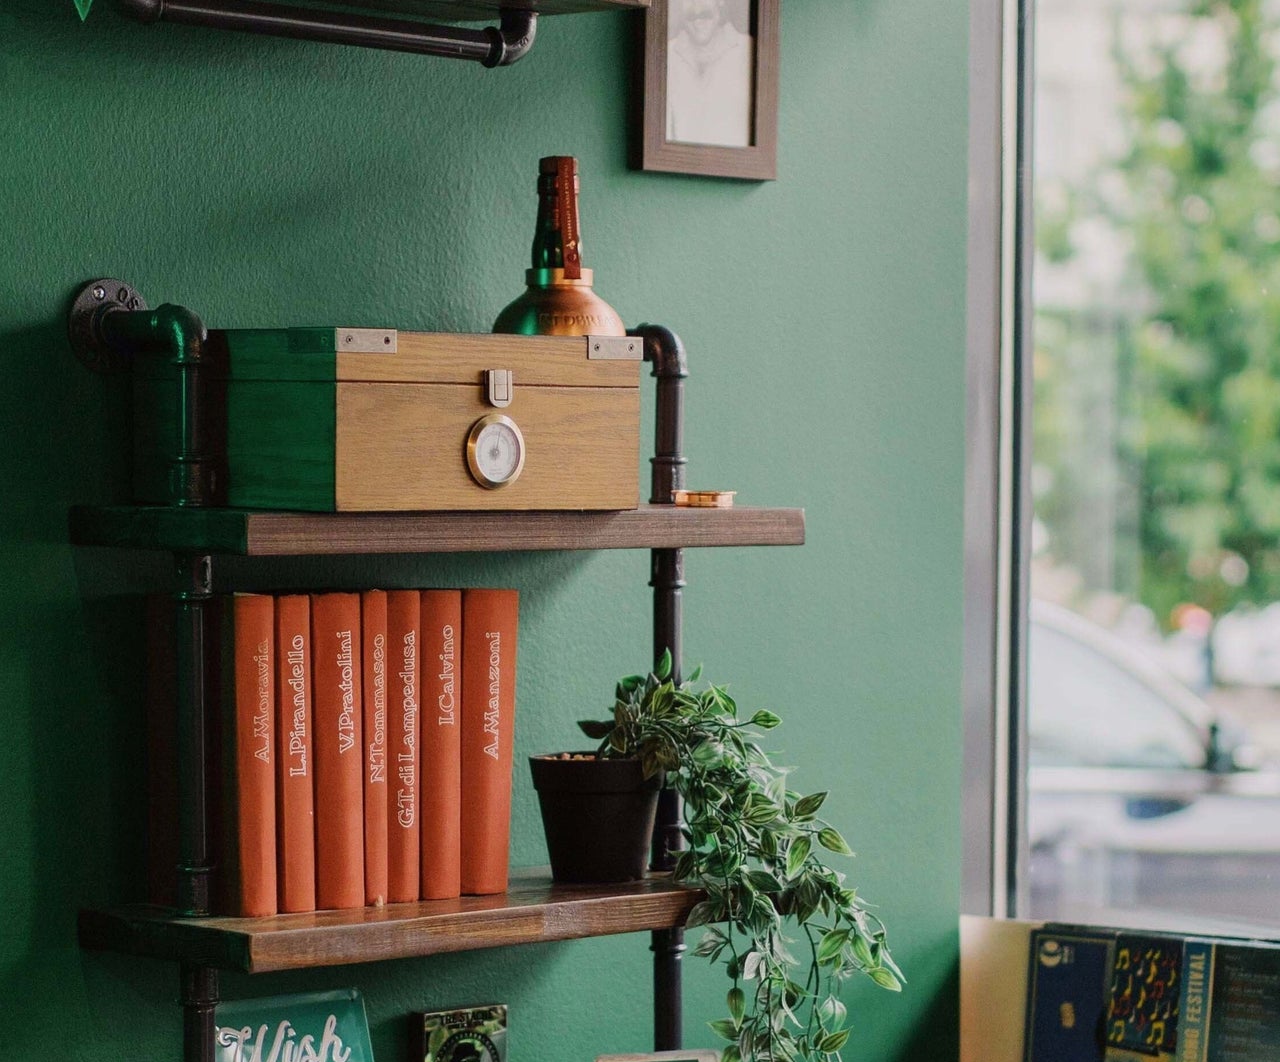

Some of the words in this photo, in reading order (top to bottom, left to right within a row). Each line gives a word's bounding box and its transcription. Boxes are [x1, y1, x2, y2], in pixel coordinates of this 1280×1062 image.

[253, 638, 270, 764] A.Moravia
[289, 633, 307, 778] L.Pirandello
[337, 630, 353, 754] V.Pratolini
[370, 633, 385, 783] N.Tommaseo
[398, 630, 418, 762] Lampedusa
[438, 624, 454, 726] I.Calvino
[483, 631, 501, 760] A.Manzoni
[1186, 953, 1207, 1024] FESTIVAL
